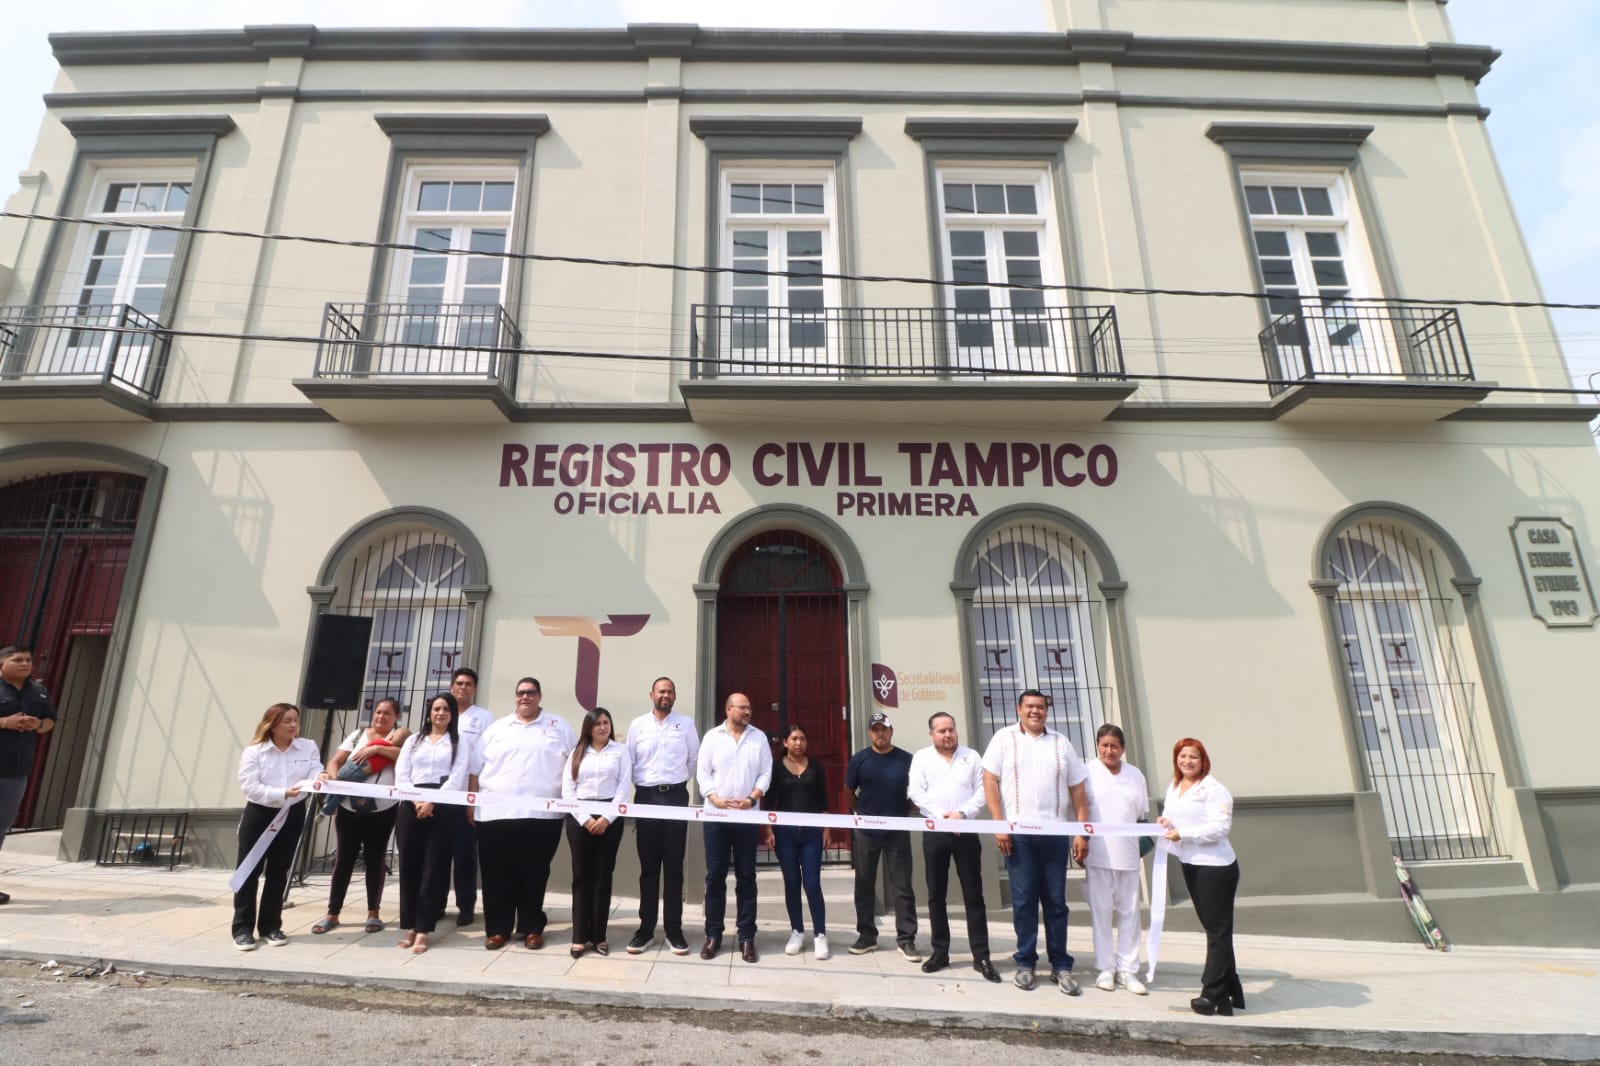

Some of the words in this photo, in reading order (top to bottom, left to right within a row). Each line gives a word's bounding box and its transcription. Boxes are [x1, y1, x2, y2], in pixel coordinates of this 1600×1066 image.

[499, 443, 731, 487] REGISTRO
[752, 442, 882, 487] CIVIL
[898, 442, 1119, 488] TAMPICO
[553, 491, 721, 515] OFICIALIA
[837, 492, 980, 517] PRIMERA
[1527, 528, 1560, 544] CASA
